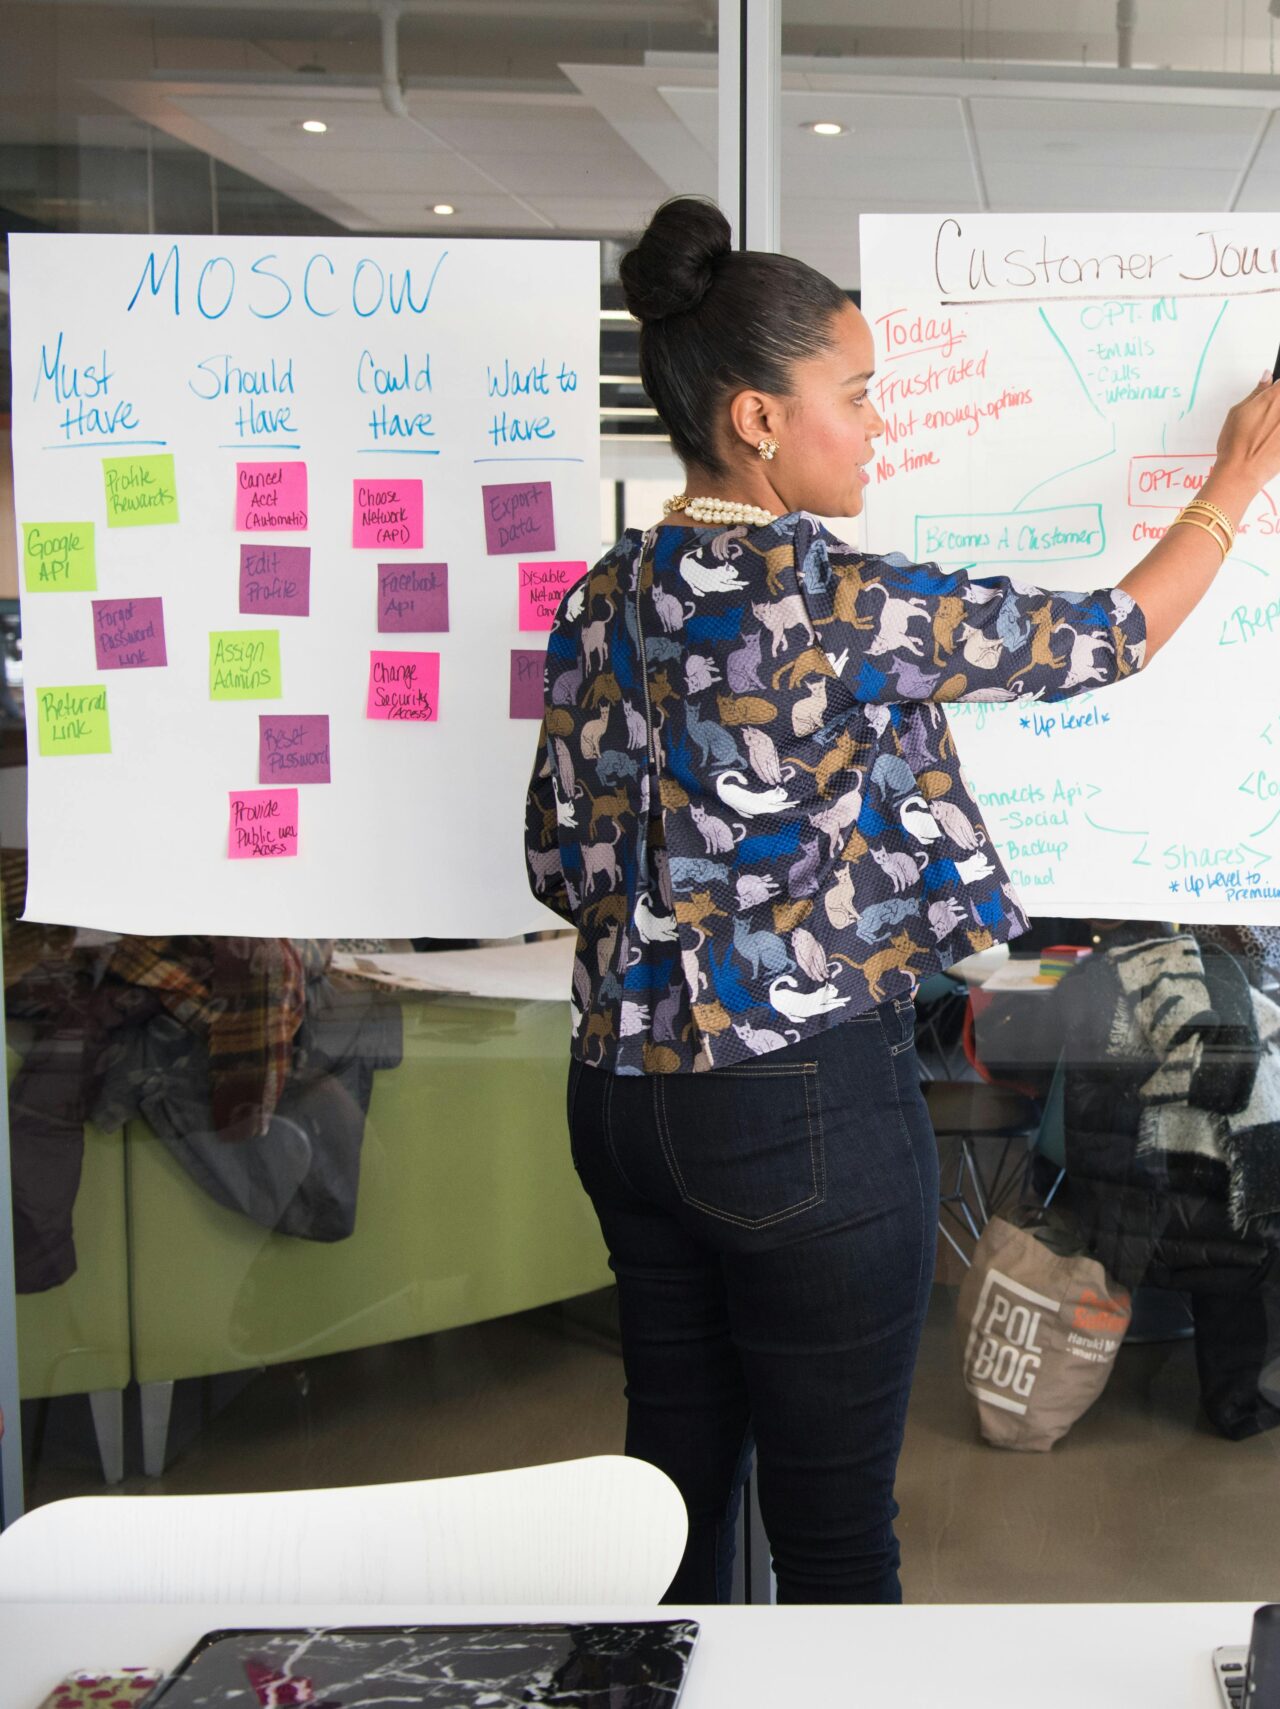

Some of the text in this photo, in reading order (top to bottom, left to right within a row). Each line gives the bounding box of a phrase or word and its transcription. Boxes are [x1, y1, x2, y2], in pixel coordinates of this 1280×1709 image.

[934, 218, 1173, 294] Customer
[127, 244, 449, 319] MOSCOW
[33, 331, 115, 404] Must
[188, 354, 295, 400] Should
[357, 350, 433, 395] Could
[487, 358, 578, 397] Want to
[875, 350, 989, 412] Frustrated
[60, 399, 140, 440] Have
[235, 398, 299, 438] Have
[368, 404, 436, 441] Have
[488, 411, 556, 447] Have
[884, 410, 919, 446] Not
[106, 465, 156, 495] Profile
[240, 468, 283, 490] Cancel
[876, 447, 940, 484] No time
[112, 487, 175, 514] Rewards
[251, 490, 279, 508] Acct
[358, 487, 401, 508] Choose
[491, 486, 544, 522] Export
[362, 508, 408, 527] Network
[498, 517, 541, 548] Data
[27, 528, 84, 561] Google
[376, 528, 411, 545] (API)
[997, 526, 1010, 551] A
[1017, 524, 1101, 552] Customer
[39, 559, 71, 582] API
[245, 550, 281, 577] Edit
[520, 567, 570, 588] Disable
[247, 577, 300, 604] Profile
[98, 602, 138, 633] Forgot
[119, 651, 150, 667] Link
[214, 639, 266, 672] Assign
[517, 656, 542, 682] Pri
[213, 668, 272, 692] Admins
[373, 661, 418, 689] Change
[42, 691, 107, 722] Referral
[53, 719, 93, 741] Link
[267, 744, 330, 774] Password
[967, 780, 1046, 807] onnects
[232, 800, 281, 826] Provide
[983, 1294, 1043, 1354] POL
[971, 1337, 1043, 1397] BOG
